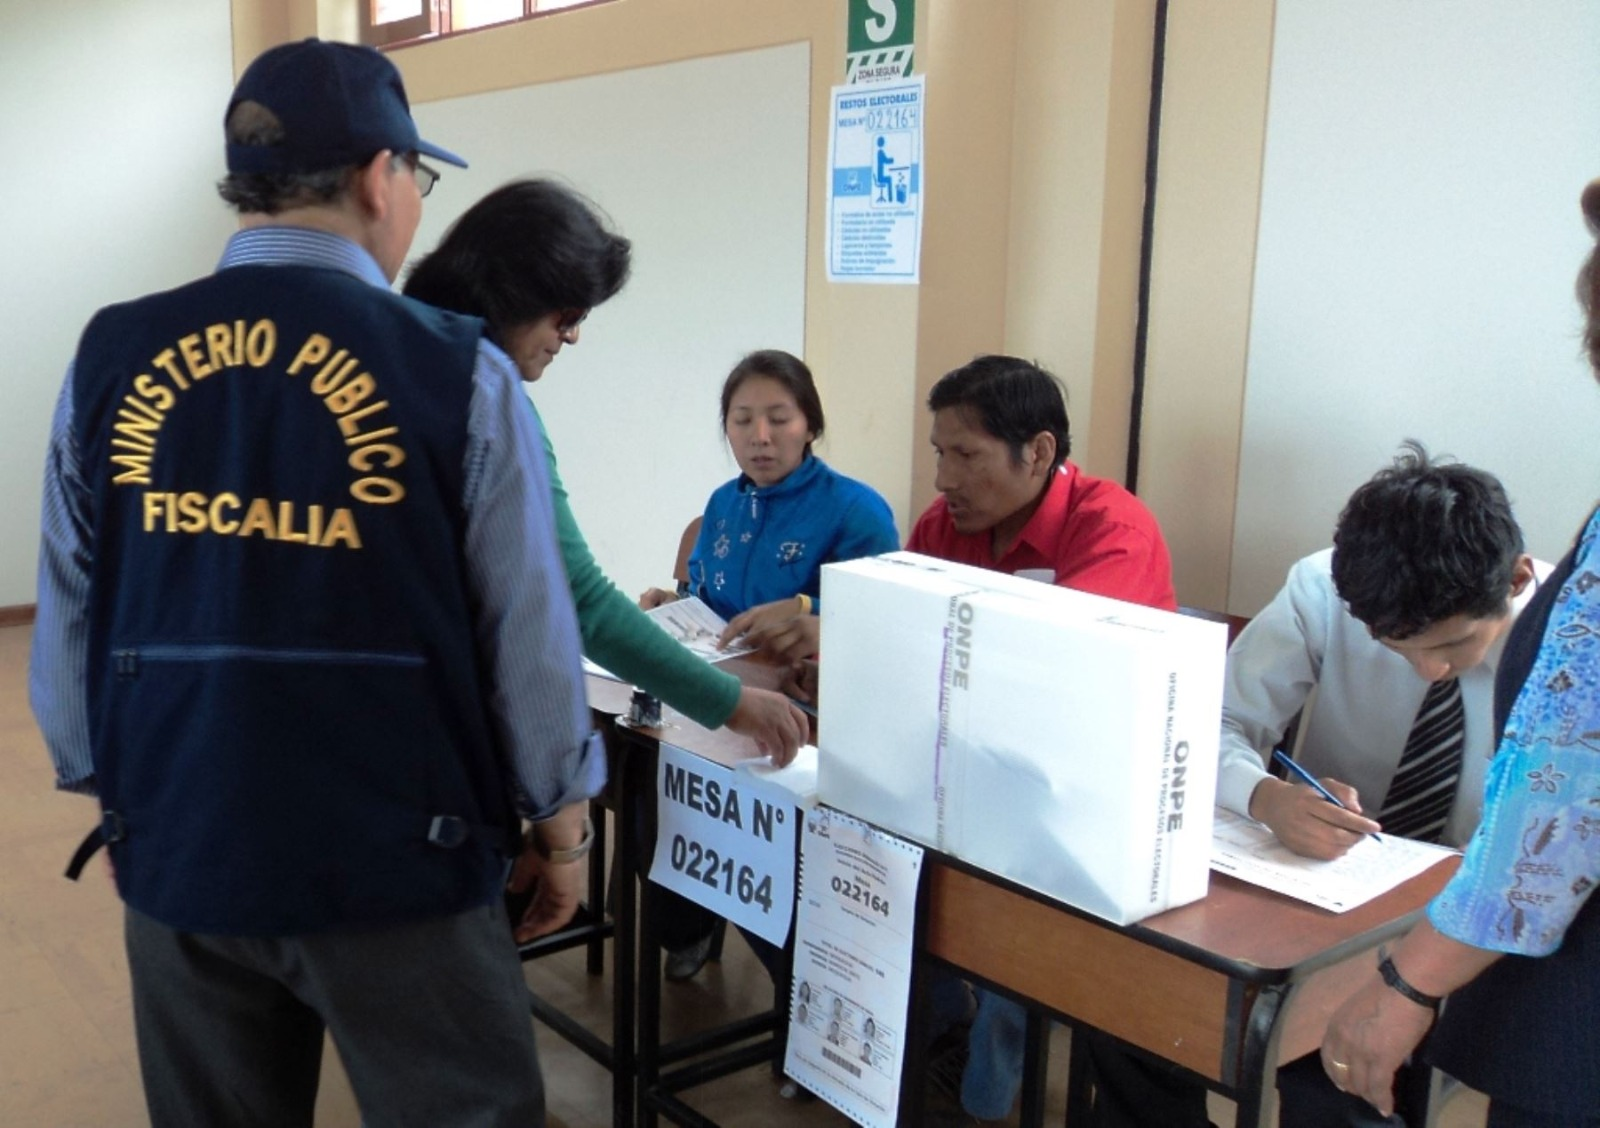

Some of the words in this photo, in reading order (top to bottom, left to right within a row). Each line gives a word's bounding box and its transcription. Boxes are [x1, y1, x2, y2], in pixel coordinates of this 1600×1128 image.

[840, 97, 867, 109] RESTOS
[869, 92, 918, 106] ELECTORALES
[858, 69, 874, 80] ZONA
[875, 66, 900, 77] SEGURA
[867, 108, 916, 129] 022164
[110, 317, 277, 485] MINISTERIO
[286, 332, 406, 504] PUBLICO
[142, 491, 363, 549] FISCALIA
[953, 602, 974, 691] ONPE
[664, 763, 743, 830] MESA
[753, 797, 785, 843] N°
[1166, 740, 1189, 833] ONPE
[670, 833, 773, 915] 022164
[831, 876, 889, 917] 022164
